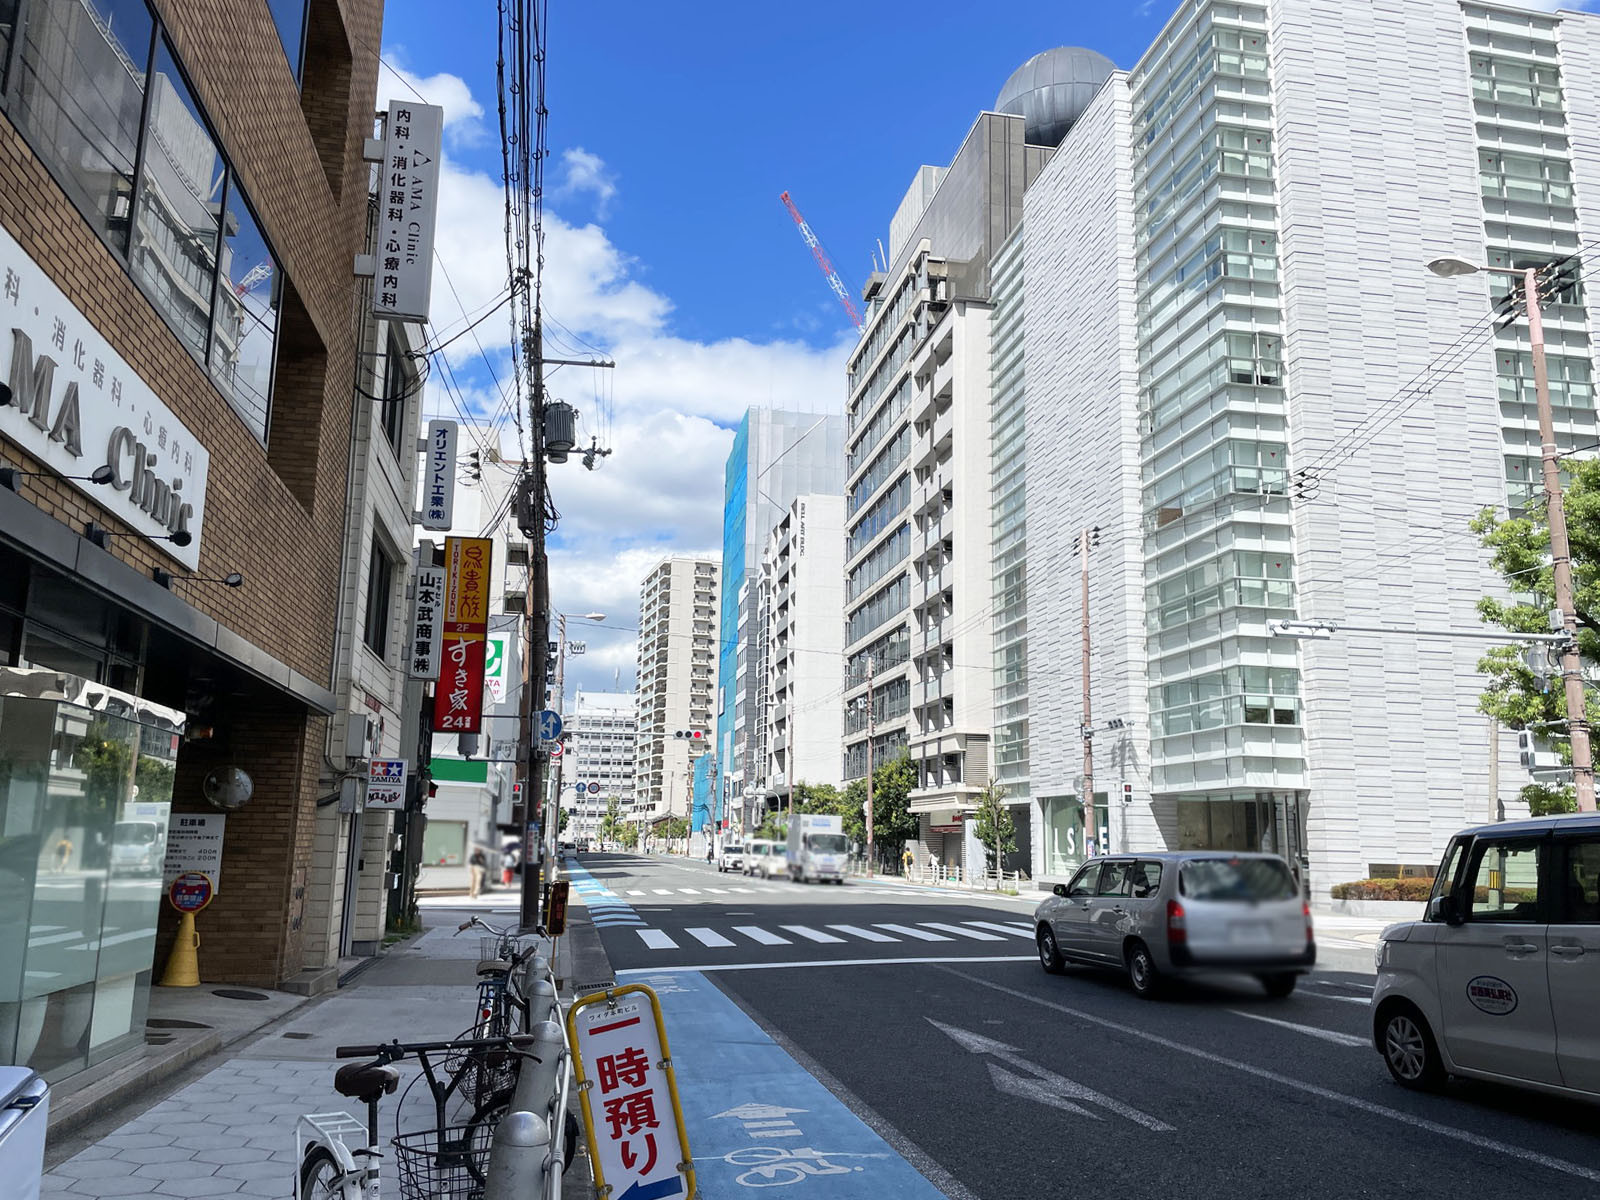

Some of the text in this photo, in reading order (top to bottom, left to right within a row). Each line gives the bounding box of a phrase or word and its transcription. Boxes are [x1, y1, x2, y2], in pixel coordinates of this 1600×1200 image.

[381, 109, 411, 307] 内科・消化器科・心療内科
[406, 175, 423, 265] AMA Clinic
[456, 624, 470, 632] 2F
[448, 636, 476, 714] すき家
[589, 1016, 661, 1177] 一時預り
